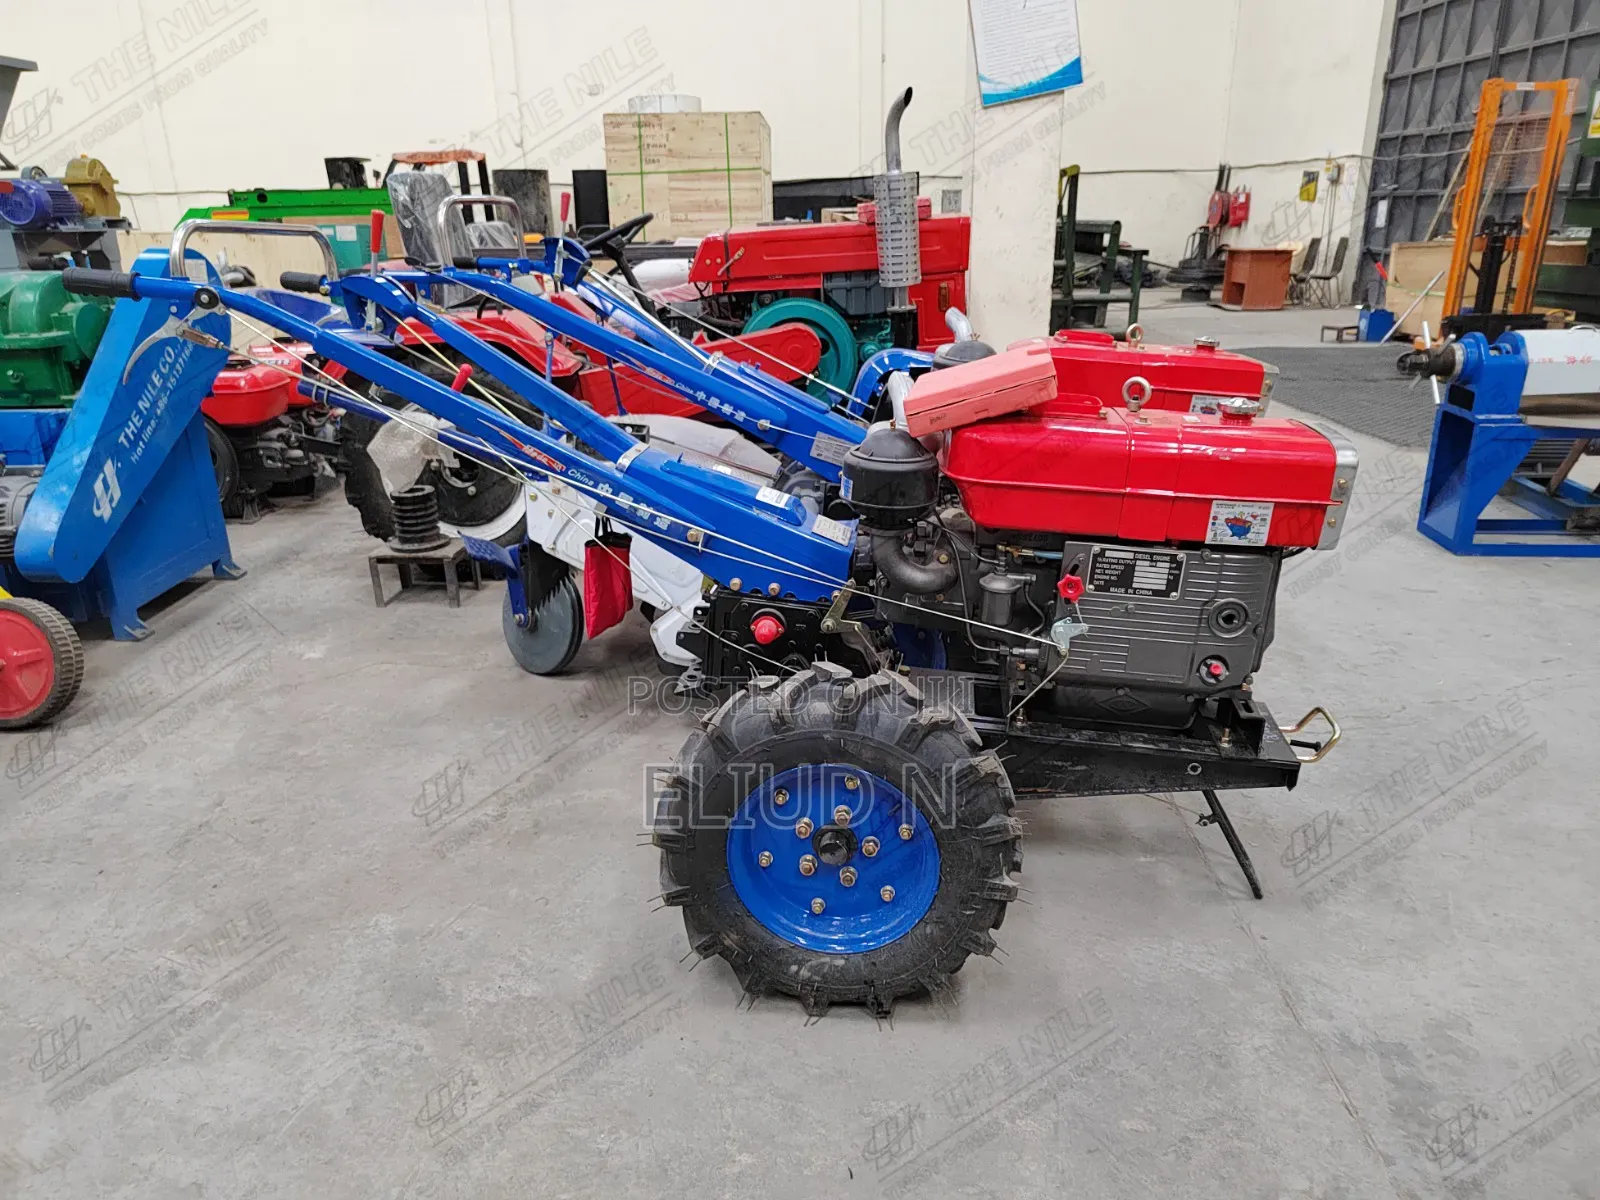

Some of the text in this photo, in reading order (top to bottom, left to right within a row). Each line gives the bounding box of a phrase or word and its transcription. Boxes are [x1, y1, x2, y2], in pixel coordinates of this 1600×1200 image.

[118, 410, 144, 449] THE
[137, 371, 164, 416] NILE
[131, 444, 146, 464] Hot
[568, 468, 594, 487] China
